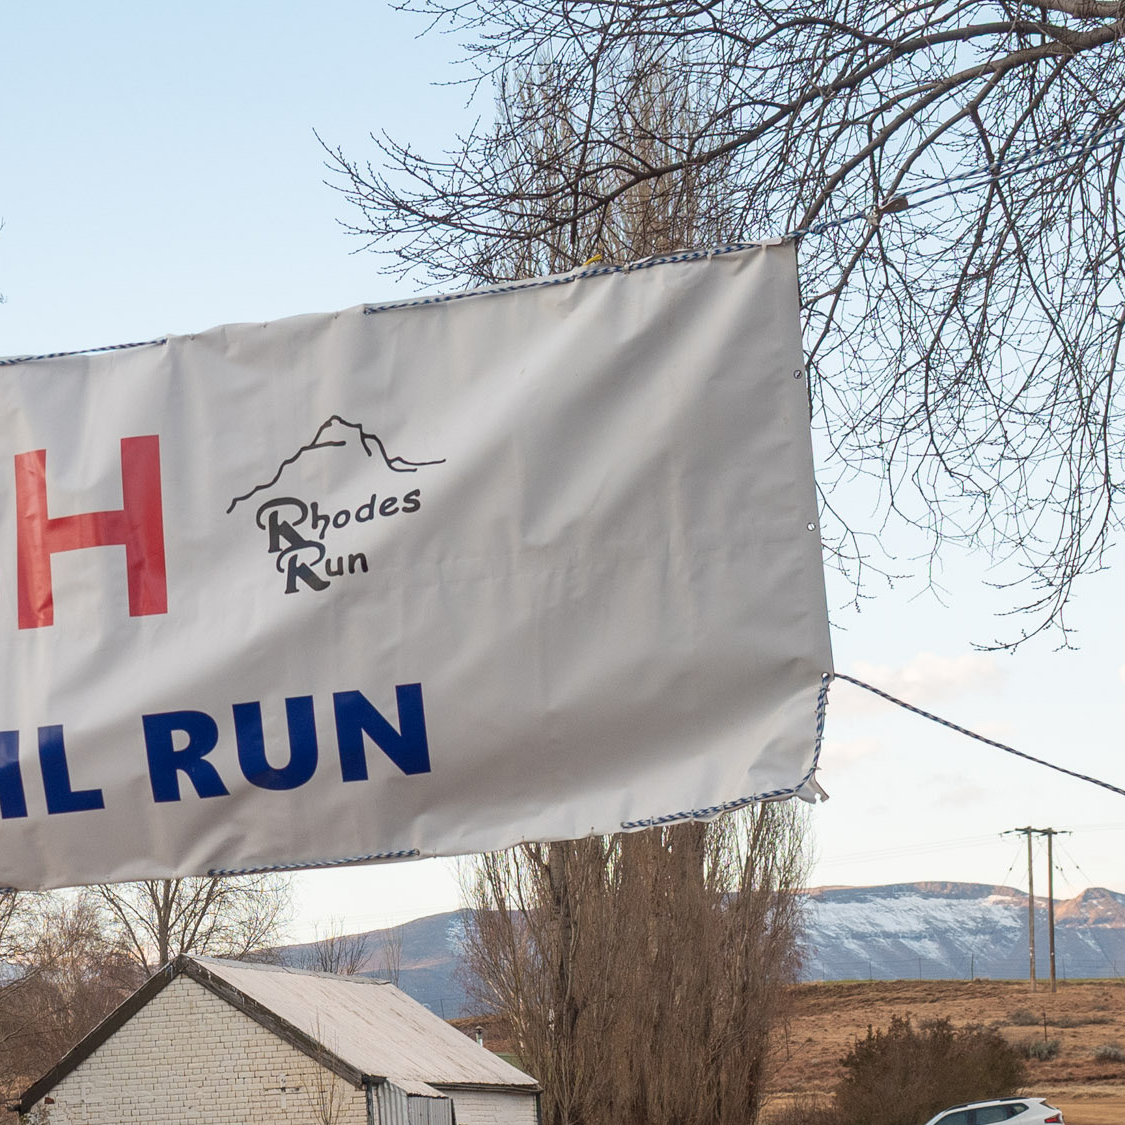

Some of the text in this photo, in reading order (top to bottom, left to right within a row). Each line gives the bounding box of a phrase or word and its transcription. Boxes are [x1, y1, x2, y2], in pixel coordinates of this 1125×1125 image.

[256, 488, 421, 553] Rhodes
[276, 541, 368, 594] Run
[141, 682, 432, 803] RUN
